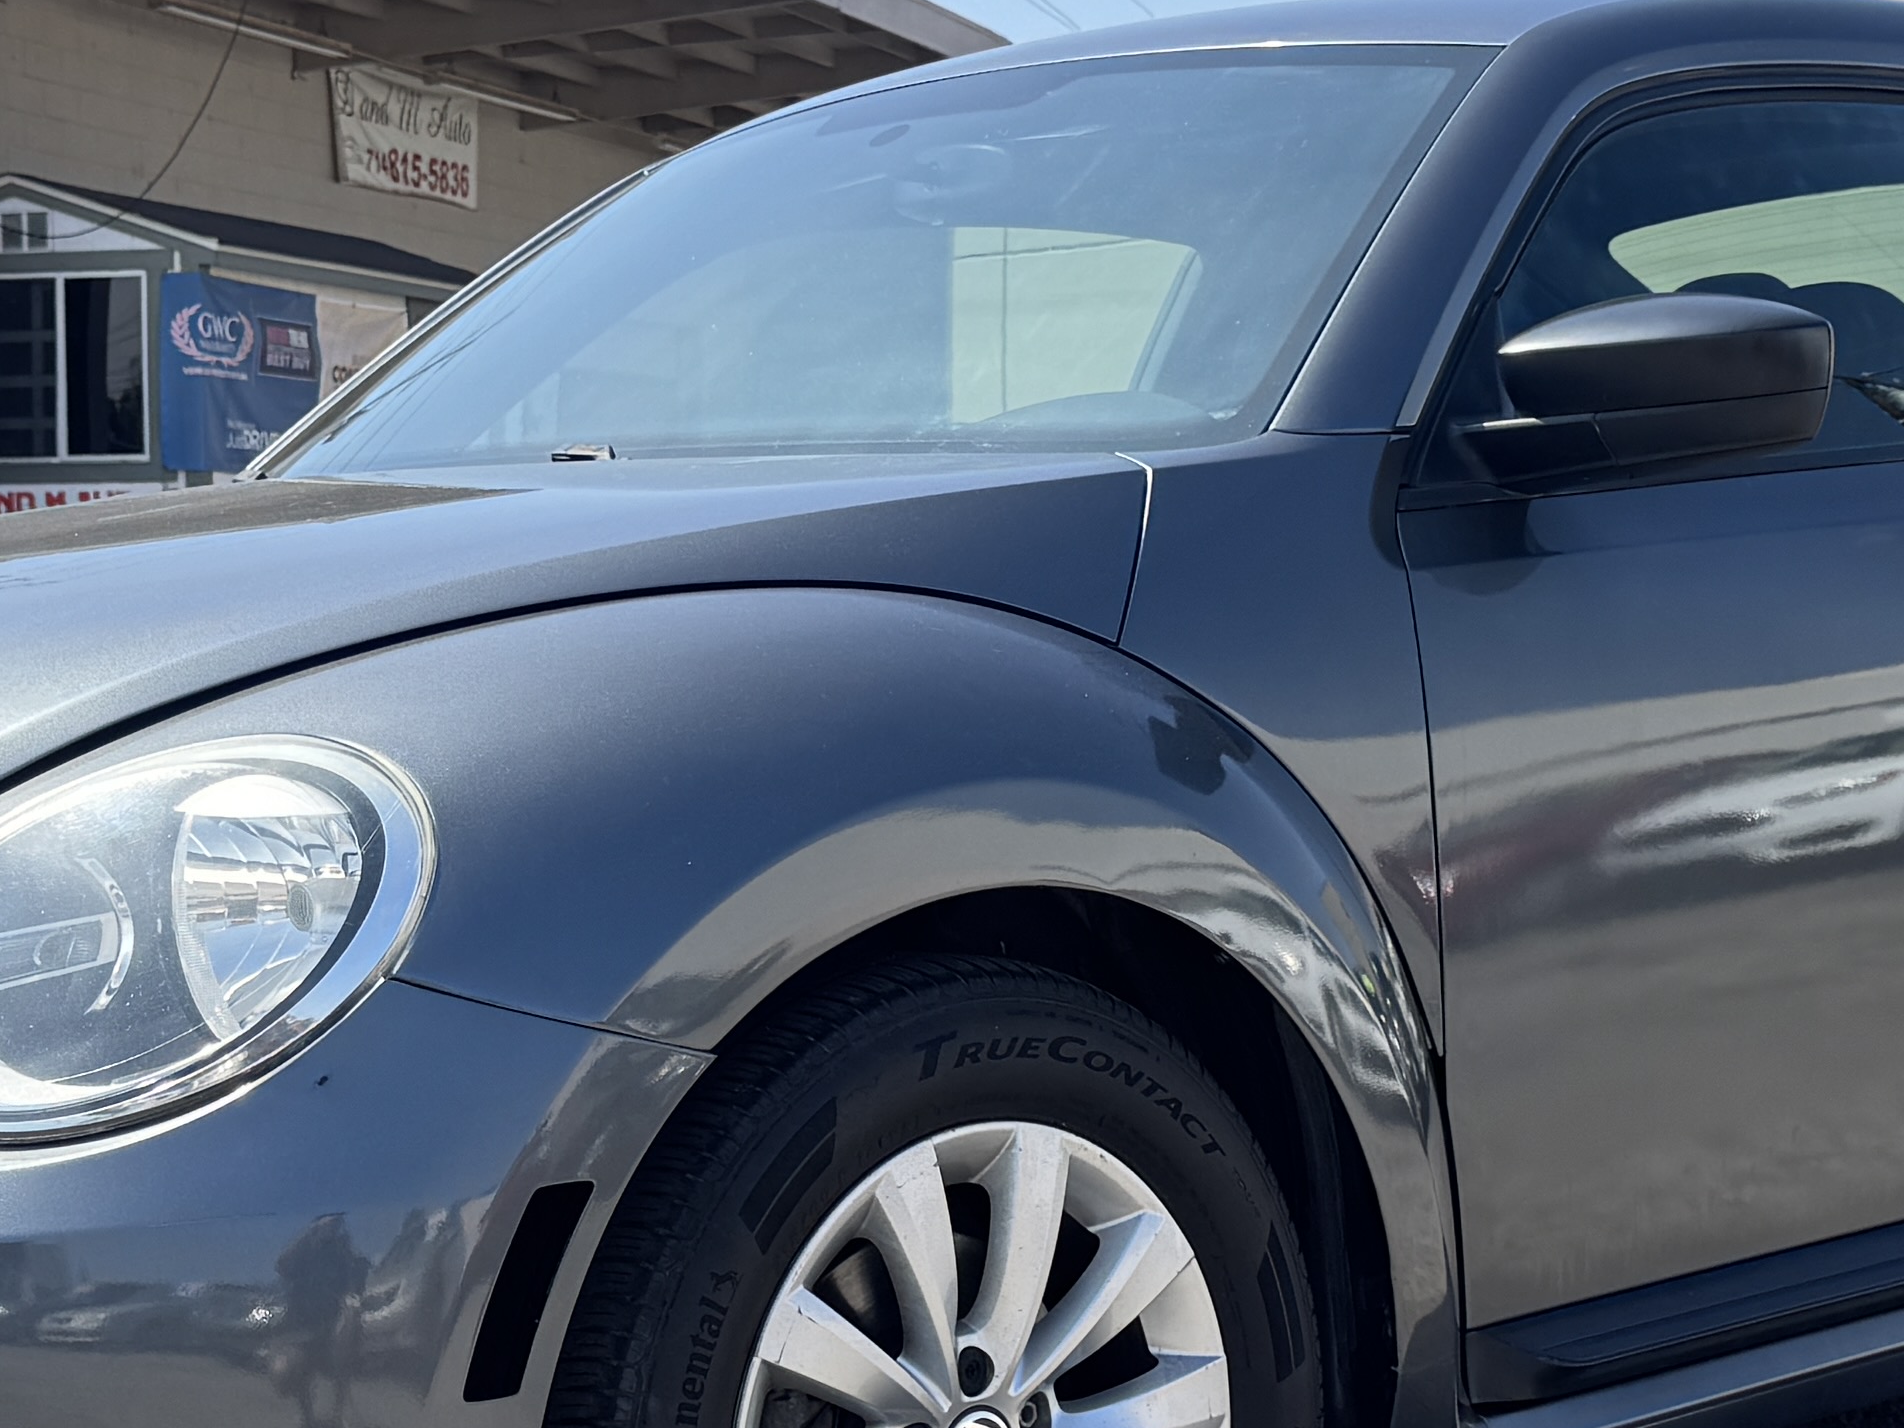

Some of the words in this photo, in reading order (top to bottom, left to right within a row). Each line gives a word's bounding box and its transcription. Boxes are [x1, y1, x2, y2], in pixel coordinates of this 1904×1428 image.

[360, 83, 394, 126] and
[428, 96, 472, 145] Auto
[198, 312, 240, 342] GWC
